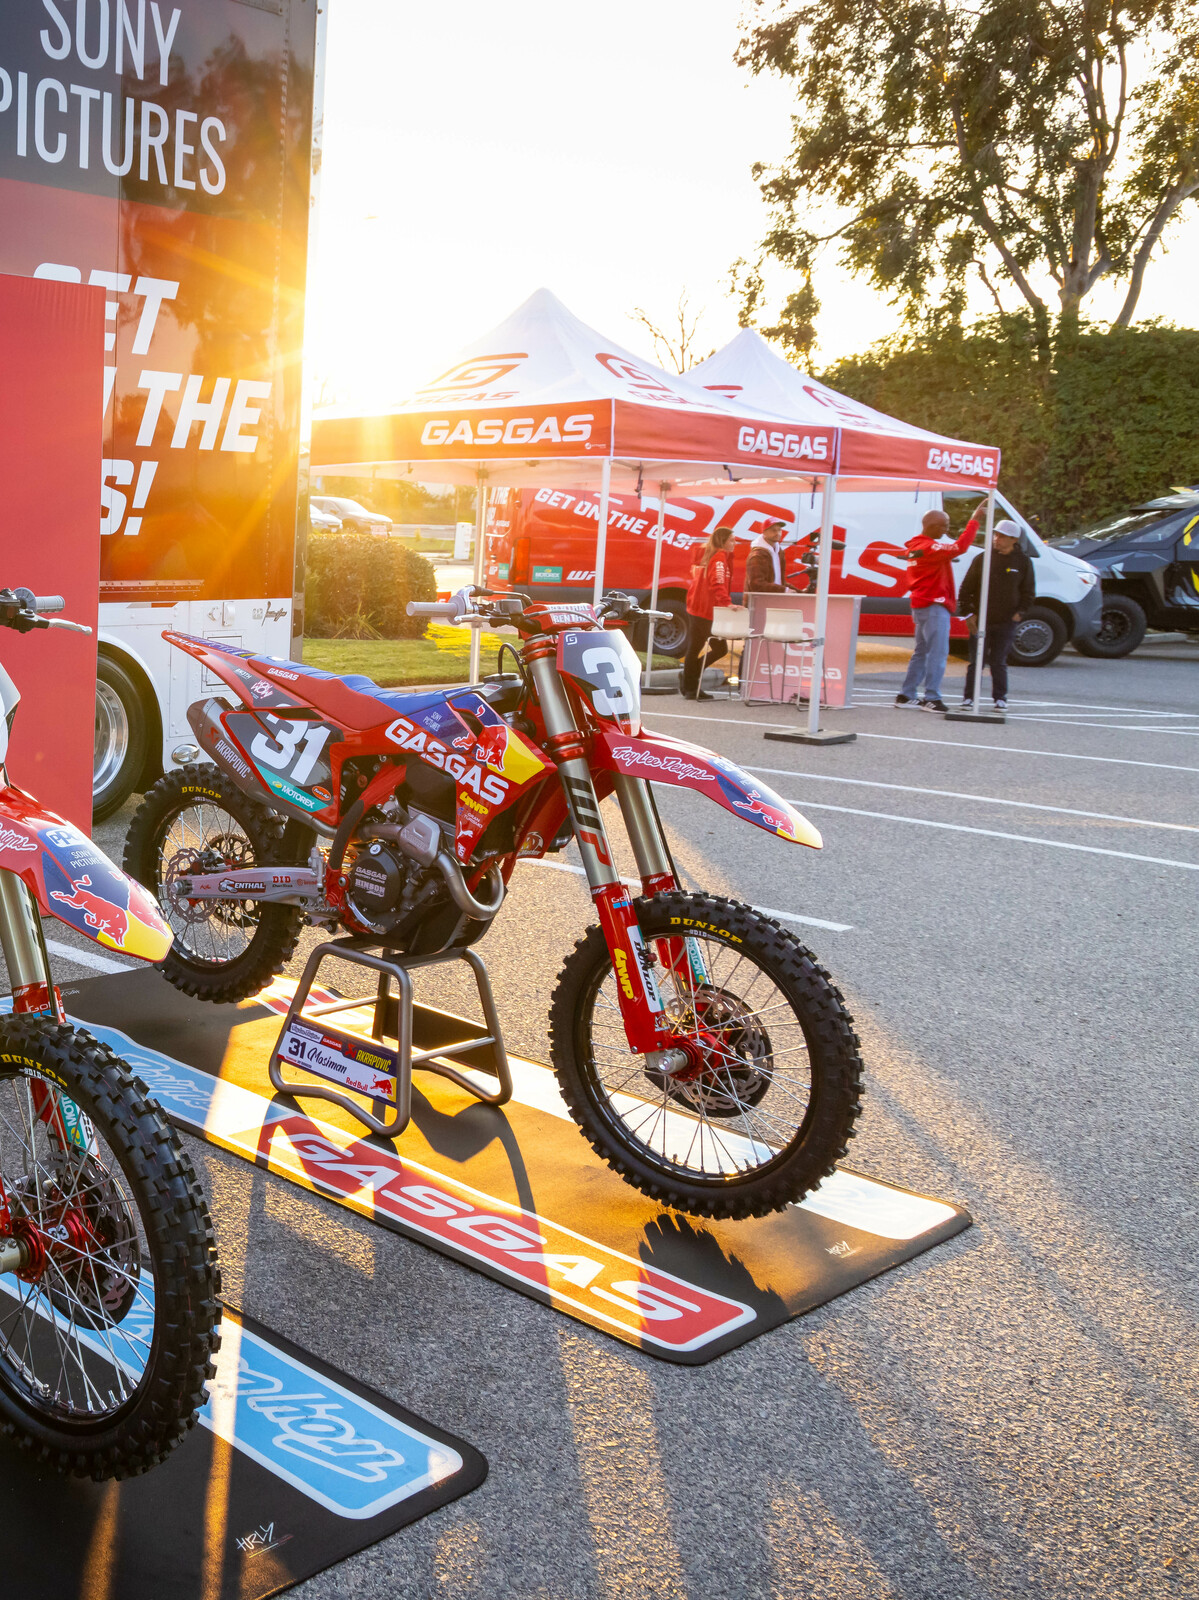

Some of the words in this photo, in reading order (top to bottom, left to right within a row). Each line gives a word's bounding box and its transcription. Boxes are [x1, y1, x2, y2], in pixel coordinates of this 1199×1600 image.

[40, 0, 182, 87] SONY
[136, 370, 272, 453] THE
[420, 414, 594, 446] GASGAS
[737, 426, 829, 461] GASGAS
[926, 447, 995, 478] GASGAS
[534, 487, 577, 510] GET
[573, 500, 600, 521] ON
[607, 510, 649, 534] THE
[646, 523, 695, 551] GAS!
[267, 667, 300, 681] GASGAS
[251, 703, 331, 785] 31
[384, 718, 510, 806] GASGAS
[612, 746, 639, 767] Troy
[635, 750, 662, 768] Lee
[658, 756, 716, 781] Designs
[181, 785, 222, 800] DUNLOP
[281, 784, 316, 810] MOTOREX
[459, 790, 490, 816] 4WP
[70, 857, 102, 868] PICTURE
[355, 866, 388, 881] GASGAS
[355, 879, 386, 895] HINSON
[670, 916, 744, 945] DUNLOP
[614, 948, 634, 999] 4WP
[634, 940, 657, 1002] DUNLOP
[0, 1053, 68, 1087] DUNLOP
[288, 1037, 307, 1059] 31
[307, 1047, 348, 1074] Mosiman
[346, 1077, 357, 1087] Red
[357, 1082, 369, 1092] Bull
[269, 1132, 702, 1323] GASGAS
